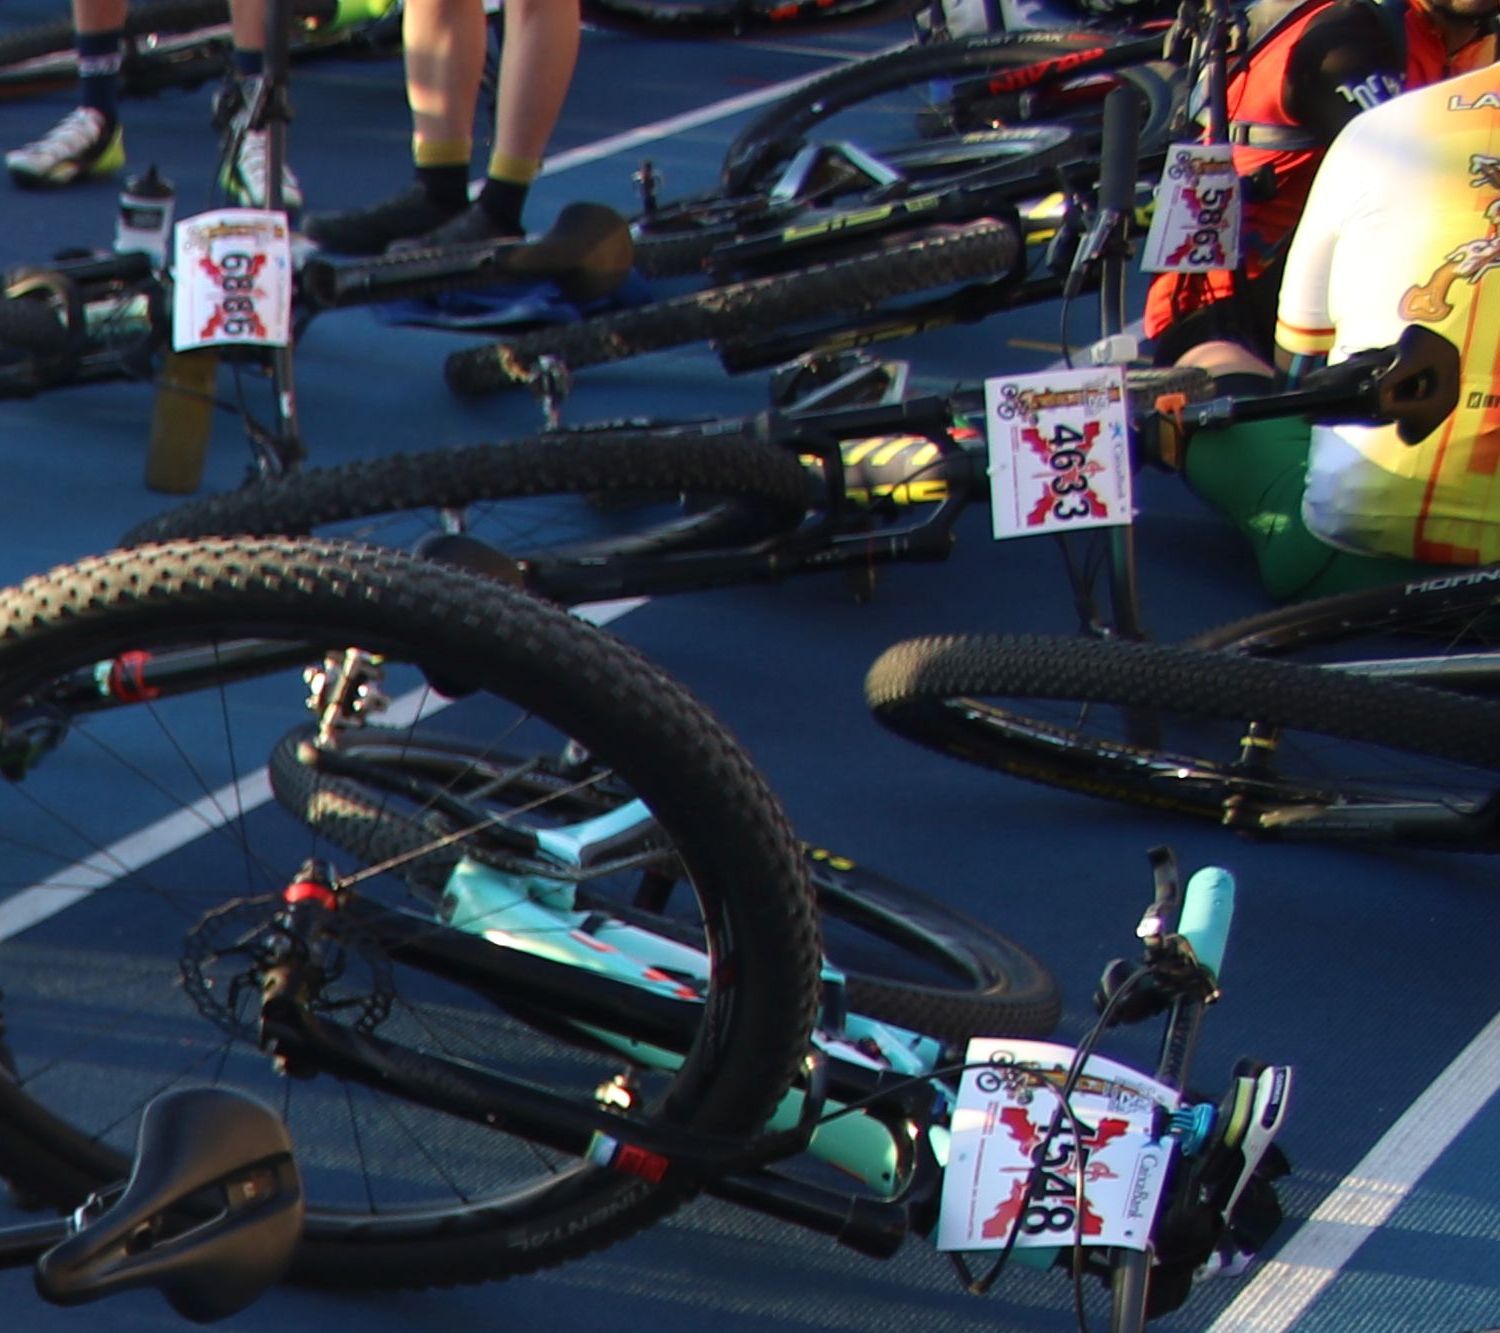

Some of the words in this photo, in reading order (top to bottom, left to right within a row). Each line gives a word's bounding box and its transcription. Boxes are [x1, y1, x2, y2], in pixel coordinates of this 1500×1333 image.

[1188, 188, 1225, 264] 5863
[221, 253, 255, 335] 6886
[1050, 424, 1091, 520] 4633
[1021, 1119, 1098, 1237] 4548
